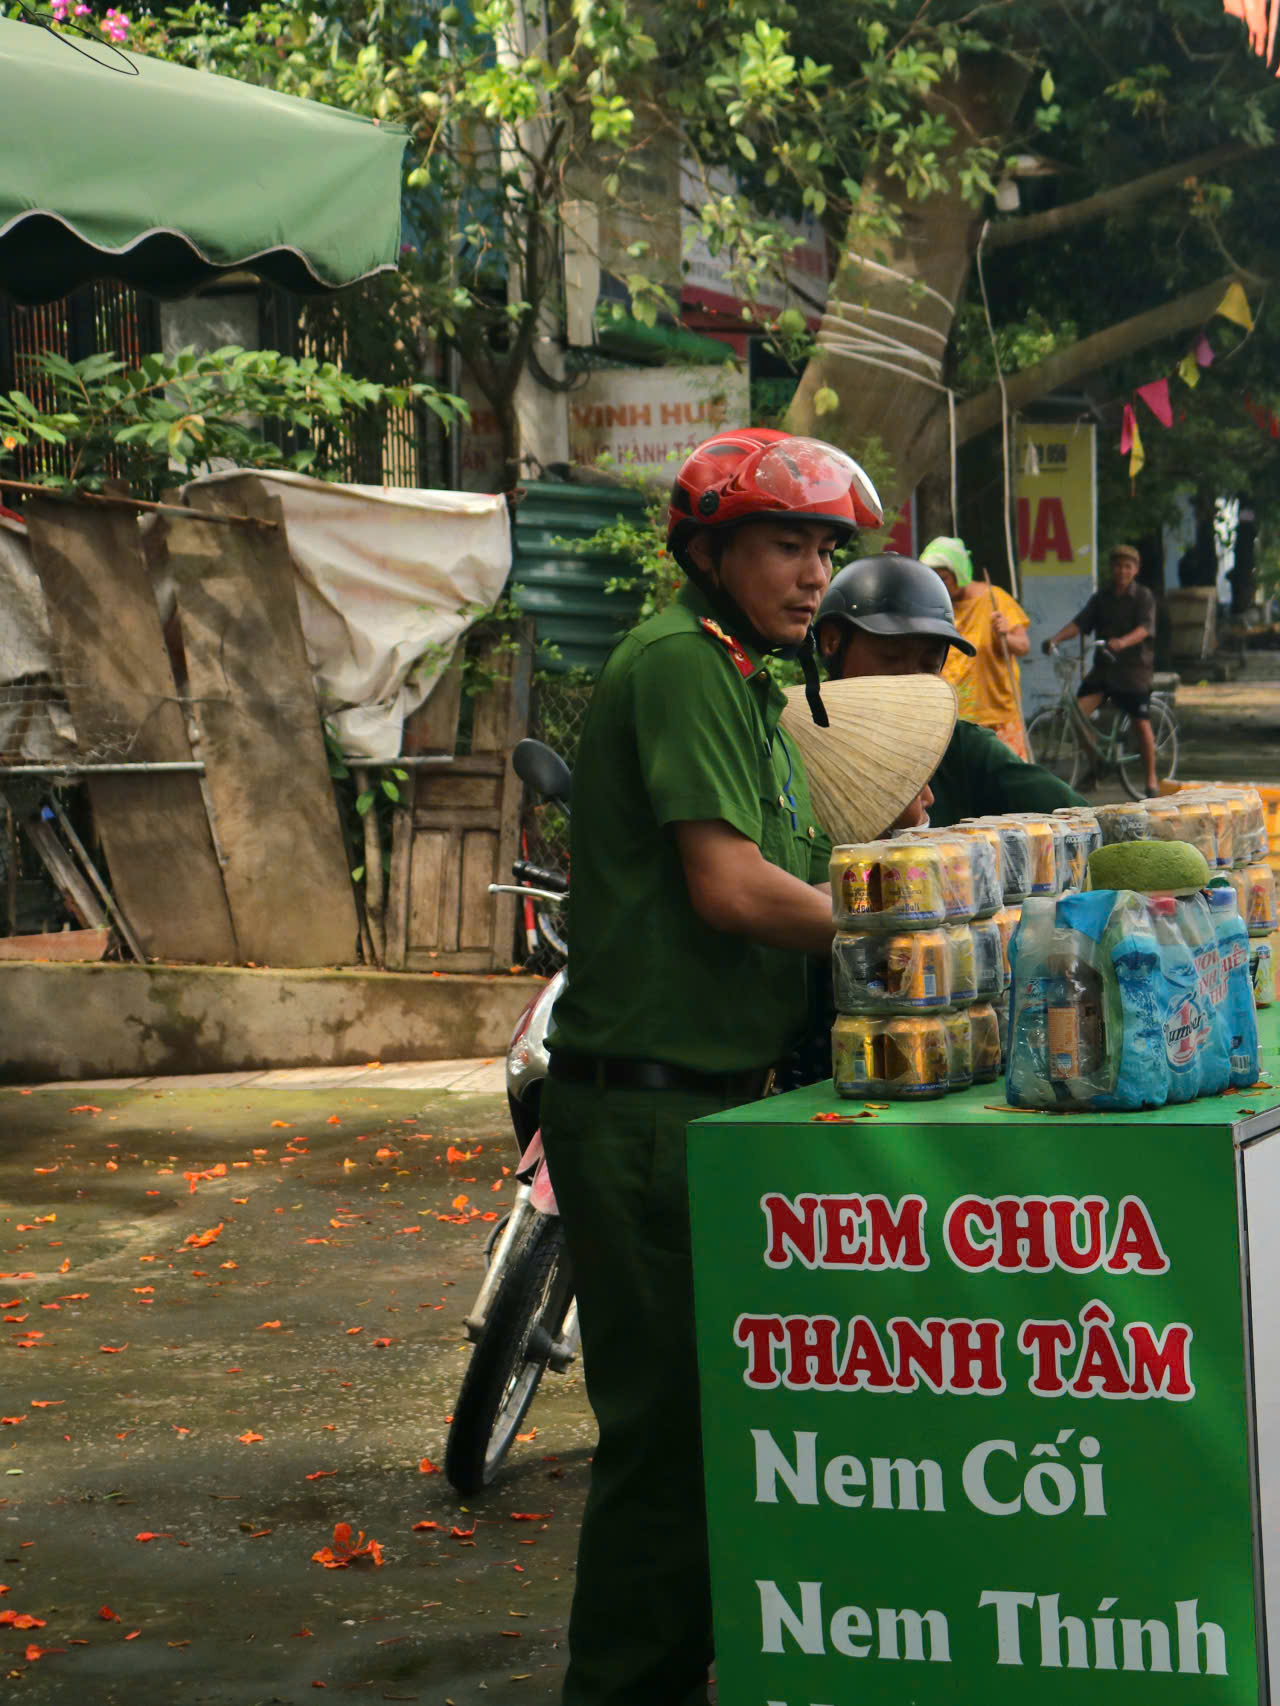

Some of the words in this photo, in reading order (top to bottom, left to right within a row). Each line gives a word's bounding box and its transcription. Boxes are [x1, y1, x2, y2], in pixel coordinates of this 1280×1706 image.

[761, 1193, 929, 1270] NEM
[943, 1194, 1170, 1274] CHUA
[734, 1313, 1005, 1394] THANH
[1018, 1299, 1195, 1400] TÂM
[750, 1429, 946, 1512] Nem
[961, 1429, 1108, 1516] Cối
[755, 1580, 953, 1663] Nem
[978, 1591, 1230, 1676] Thính
